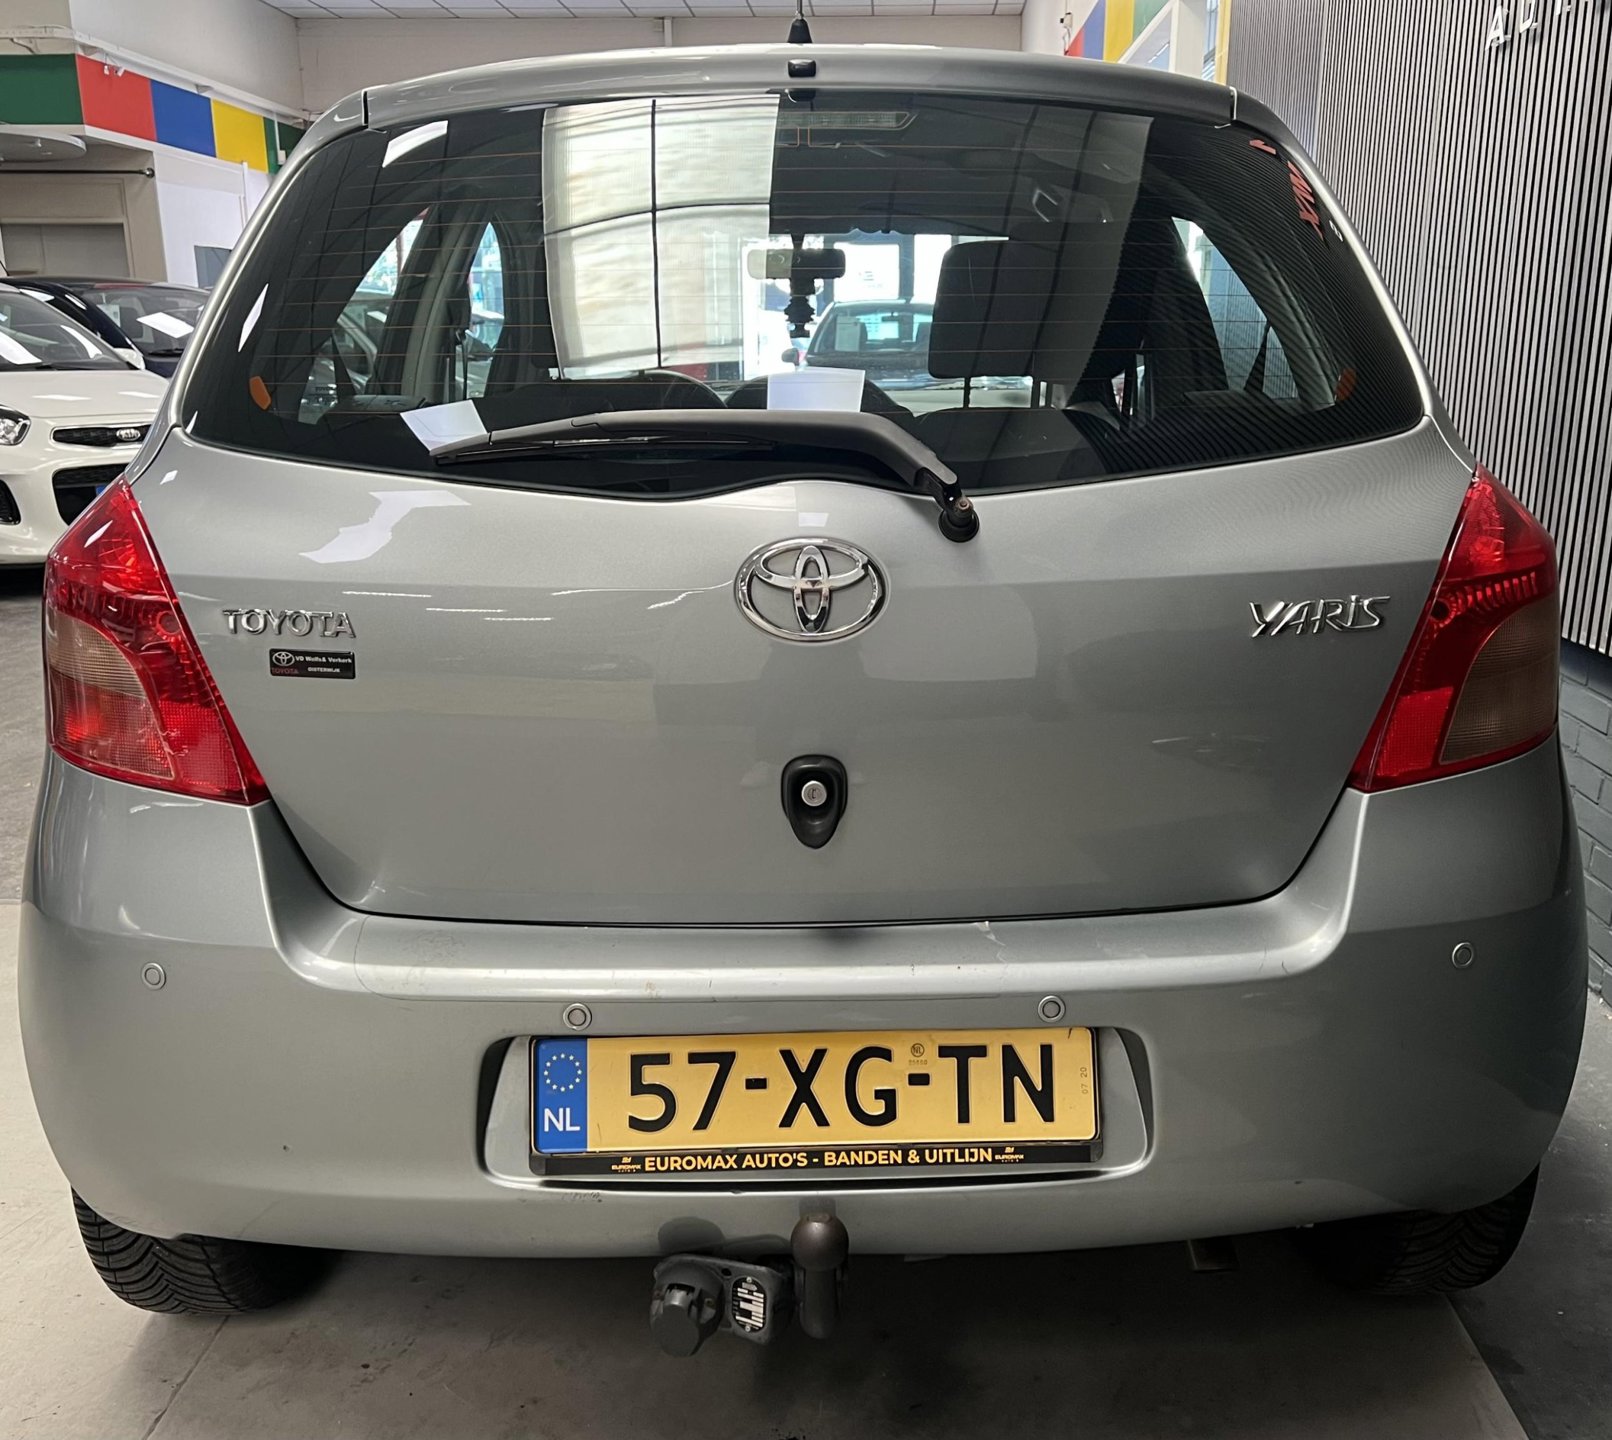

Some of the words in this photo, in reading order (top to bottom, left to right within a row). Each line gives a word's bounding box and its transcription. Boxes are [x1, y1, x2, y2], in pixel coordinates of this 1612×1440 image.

[222, 608, 356, 638] TOYOTA
[271, 666, 300, 675] TOYOTA
[628, 1044, 1055, 1133] 57-XG-TN
[544, 1107, 581, 1132] NL
[644, 1154, 738, 1172] EUROMAX
[742, 1152, 808, 1169] AUTO'S
[824, 1150, 903, 1166] BANDEN
[907, 1149, 920, 1164] &
[925, 1148, 993, 1163] UITLIJN
